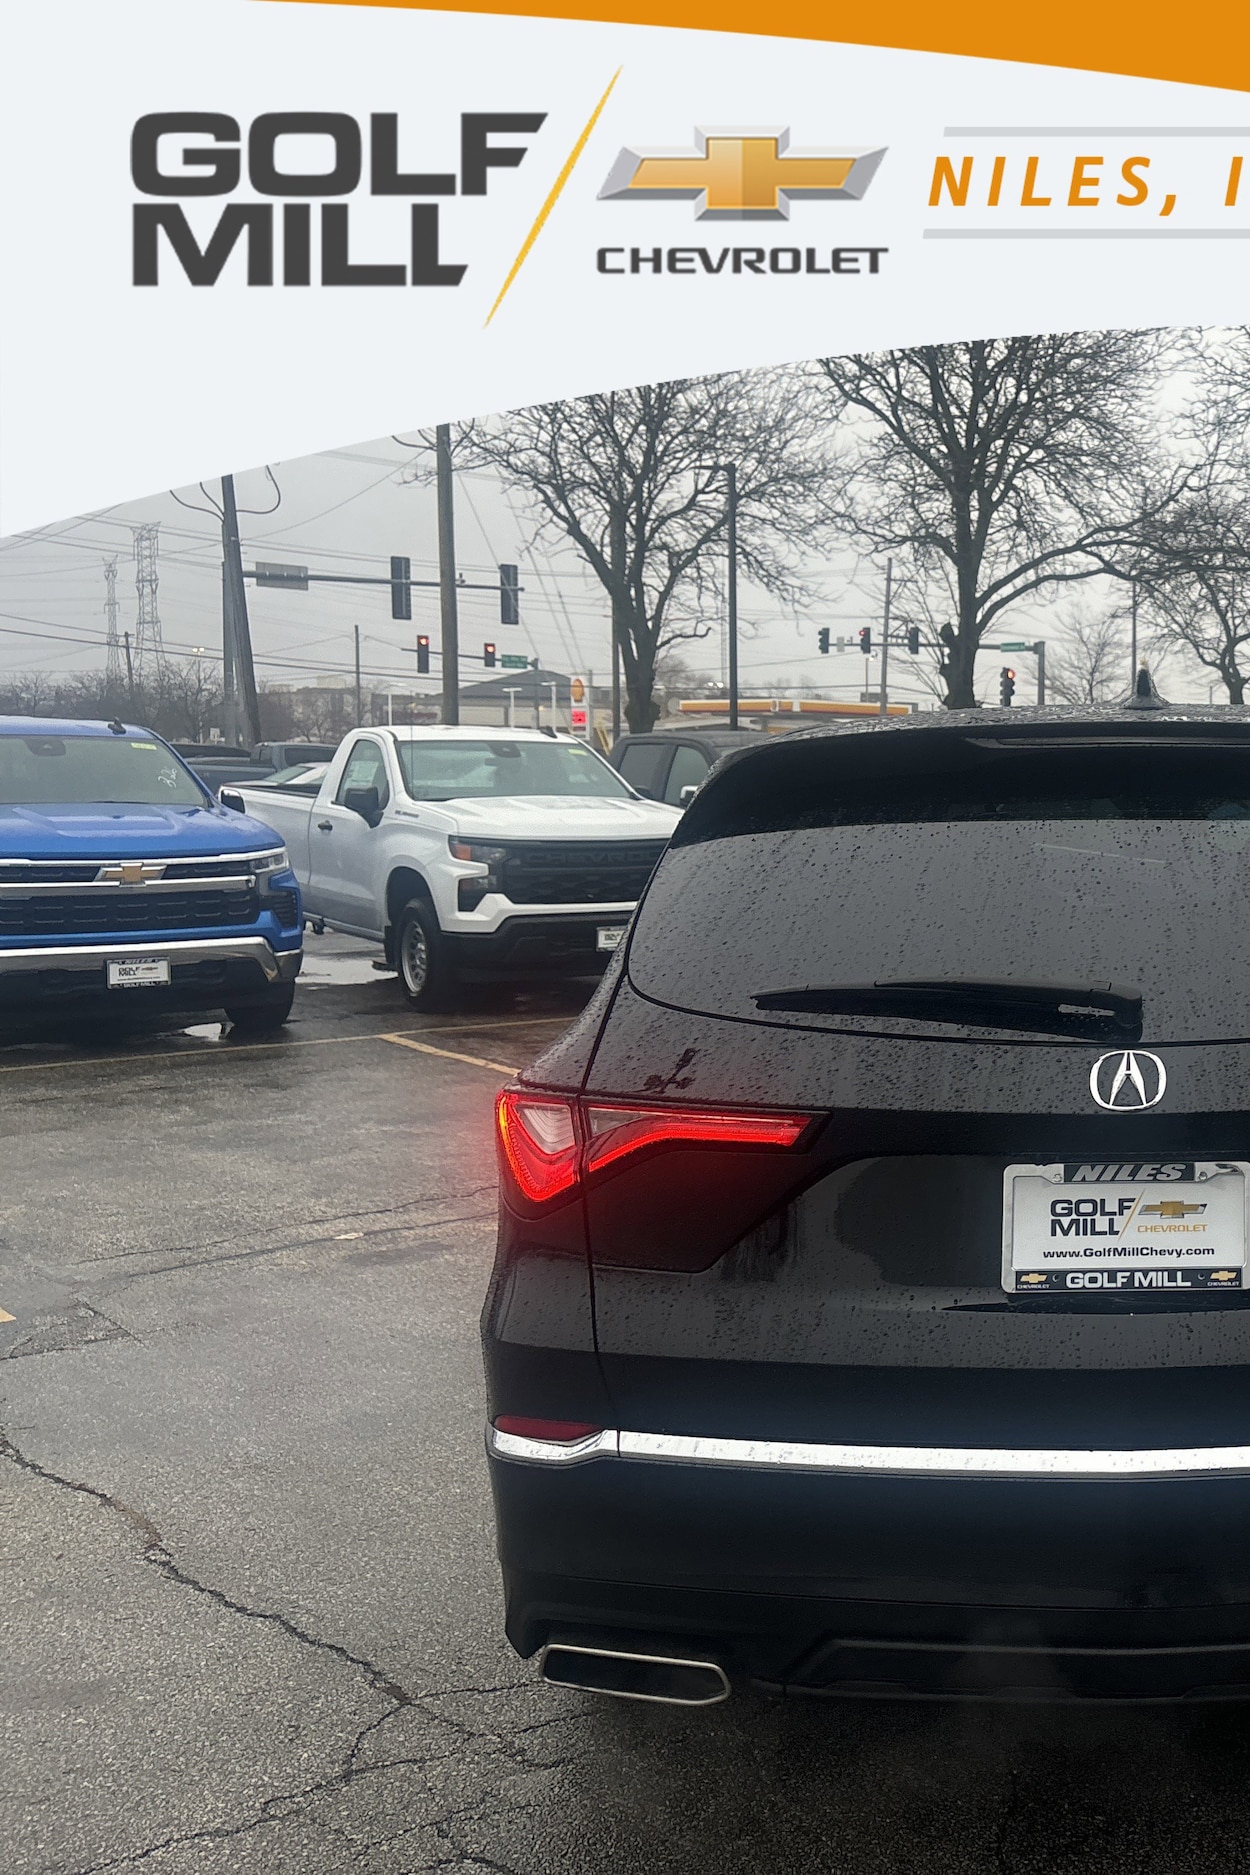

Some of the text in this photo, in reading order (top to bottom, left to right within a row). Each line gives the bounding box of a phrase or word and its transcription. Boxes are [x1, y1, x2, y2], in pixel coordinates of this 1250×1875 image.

[1071, 1163, 1187, 1182] NILES
[1050, 1197, 1138, 1218] GOLF
[1050, 1217, 1121, 1237] MILL
[1137, 1223, 1208, 1233] CHEVROLET
[1042, 1246, 1215, 1259] www.GolfMillChevy.com
[1065, 1270, 1192, 1289] GOLF MILL
